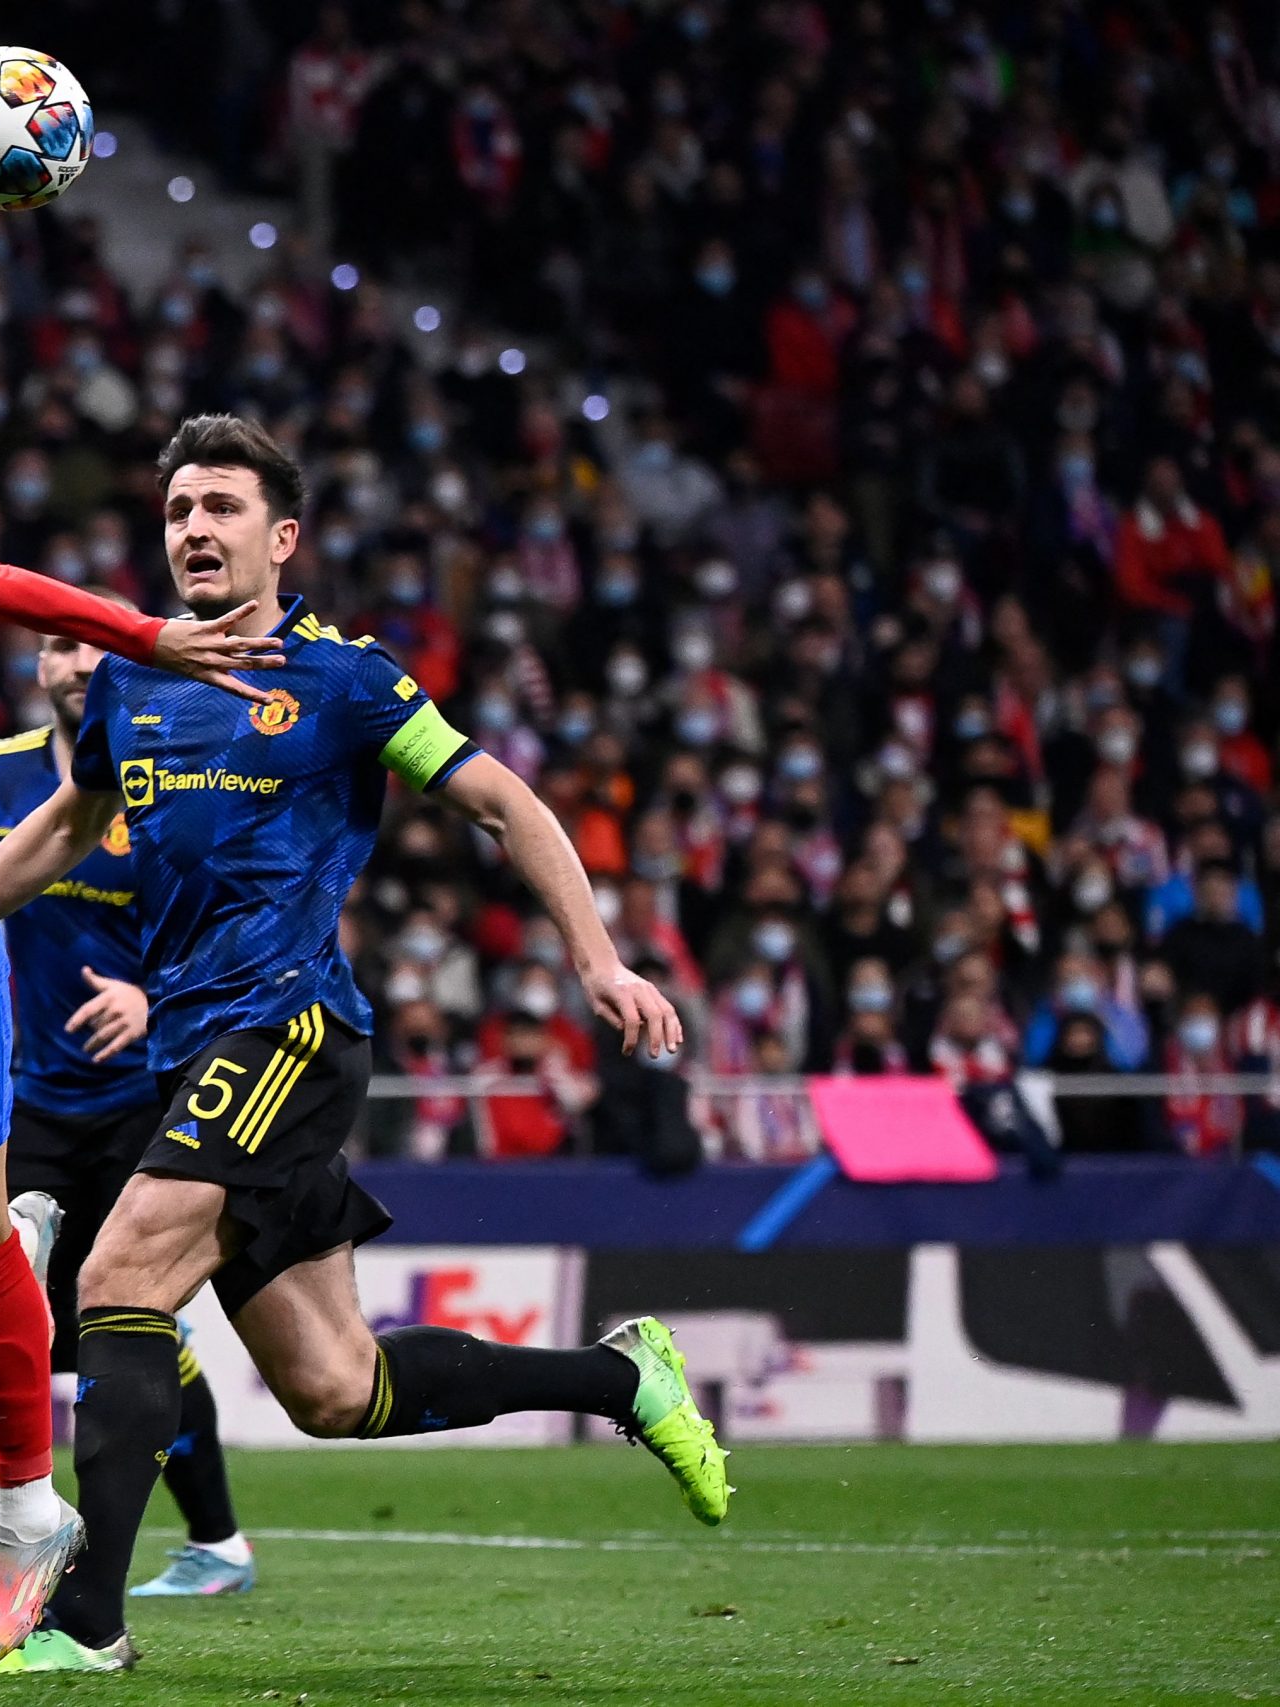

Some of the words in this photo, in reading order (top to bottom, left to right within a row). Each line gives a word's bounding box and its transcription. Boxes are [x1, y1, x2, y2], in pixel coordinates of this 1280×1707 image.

[131, 714, 161, 725] adidas
[155, 768, 283, 794] TeamViewer
[187, 1057, 247, 1120] 5
[166, 1128, 201, 1150] adidas
